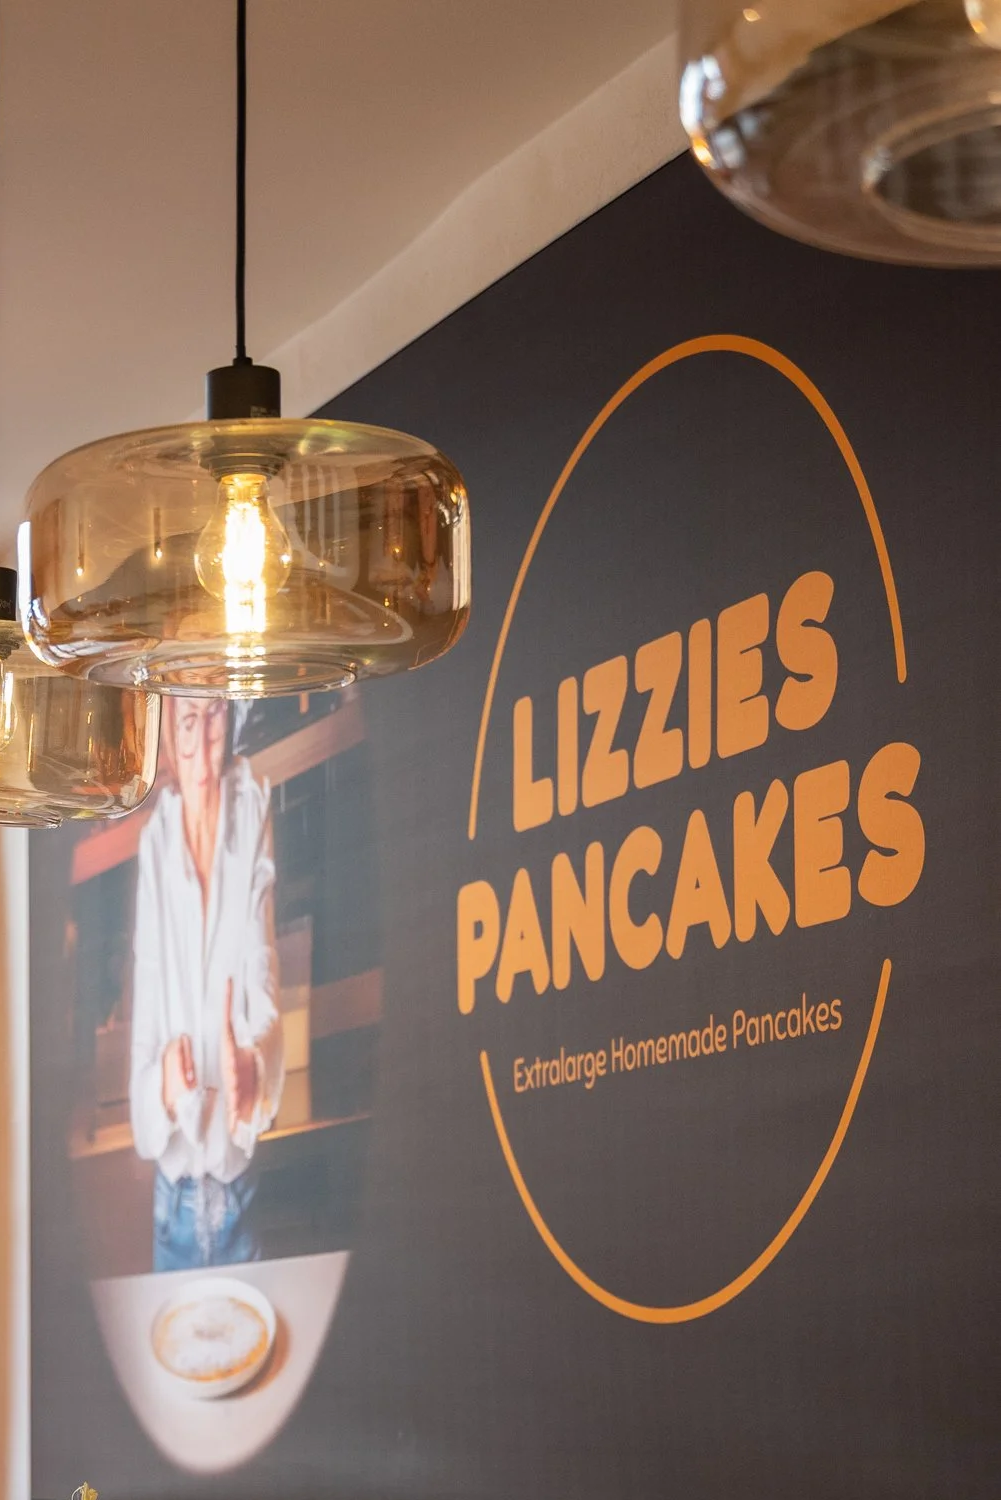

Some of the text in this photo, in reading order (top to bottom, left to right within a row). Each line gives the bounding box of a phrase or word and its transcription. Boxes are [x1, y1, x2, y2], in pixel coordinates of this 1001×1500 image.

[513, 571, 838, 832] LIZZIES
[457, 742, 925, 1015] PANCAKES
[513, 993, 842, 1093] Extralarge Homemade Pancakes
